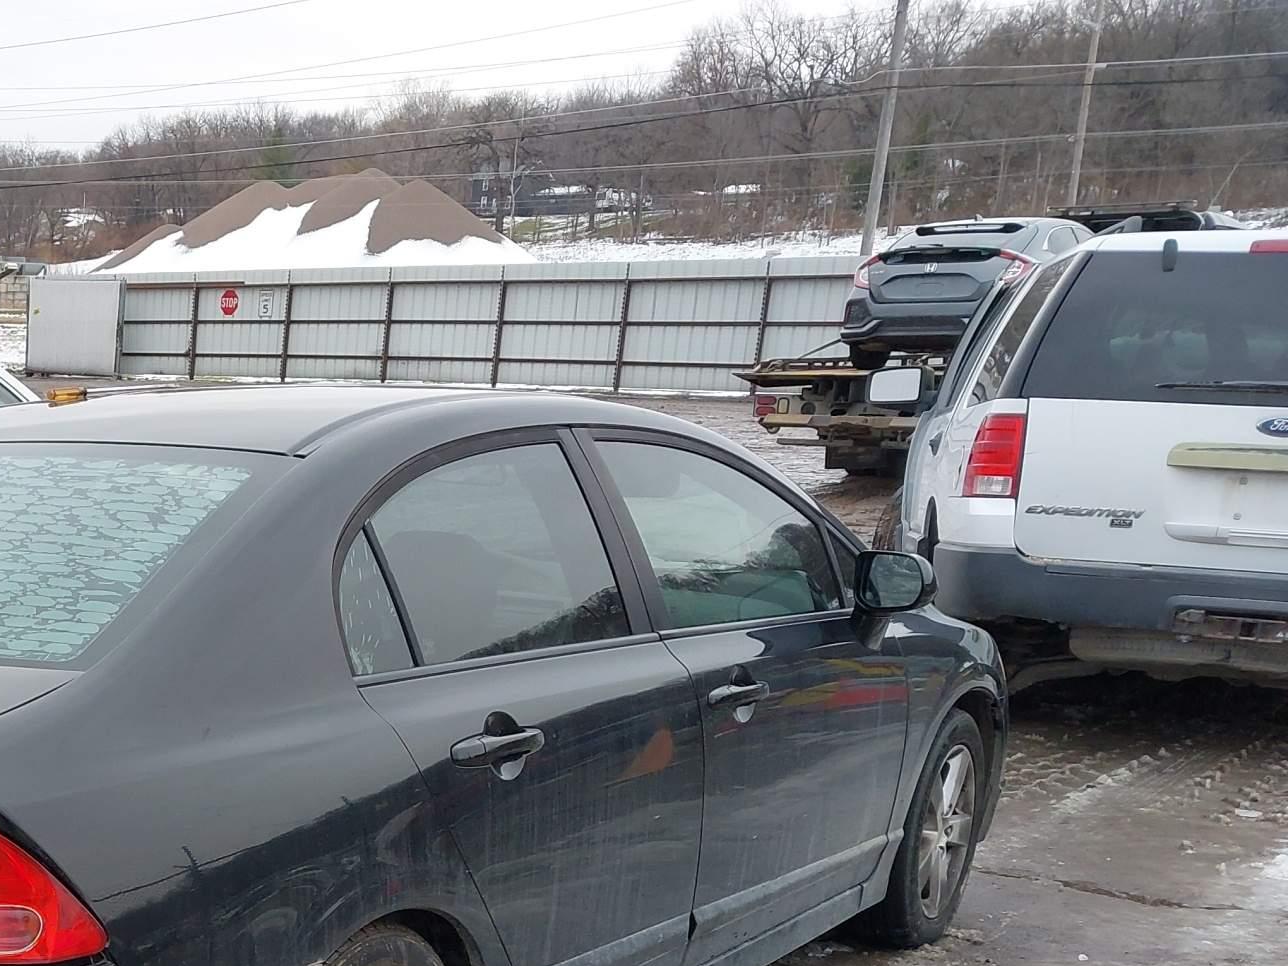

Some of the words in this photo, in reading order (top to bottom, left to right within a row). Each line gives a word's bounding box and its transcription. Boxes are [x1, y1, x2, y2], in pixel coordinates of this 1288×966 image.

[221, 297, 238, 308] STOP
[262, 303, 269, 314] 5
[1025, 504, 1146, 519] EXPEDITION
[1111, 519, 1132, 527] XLT
